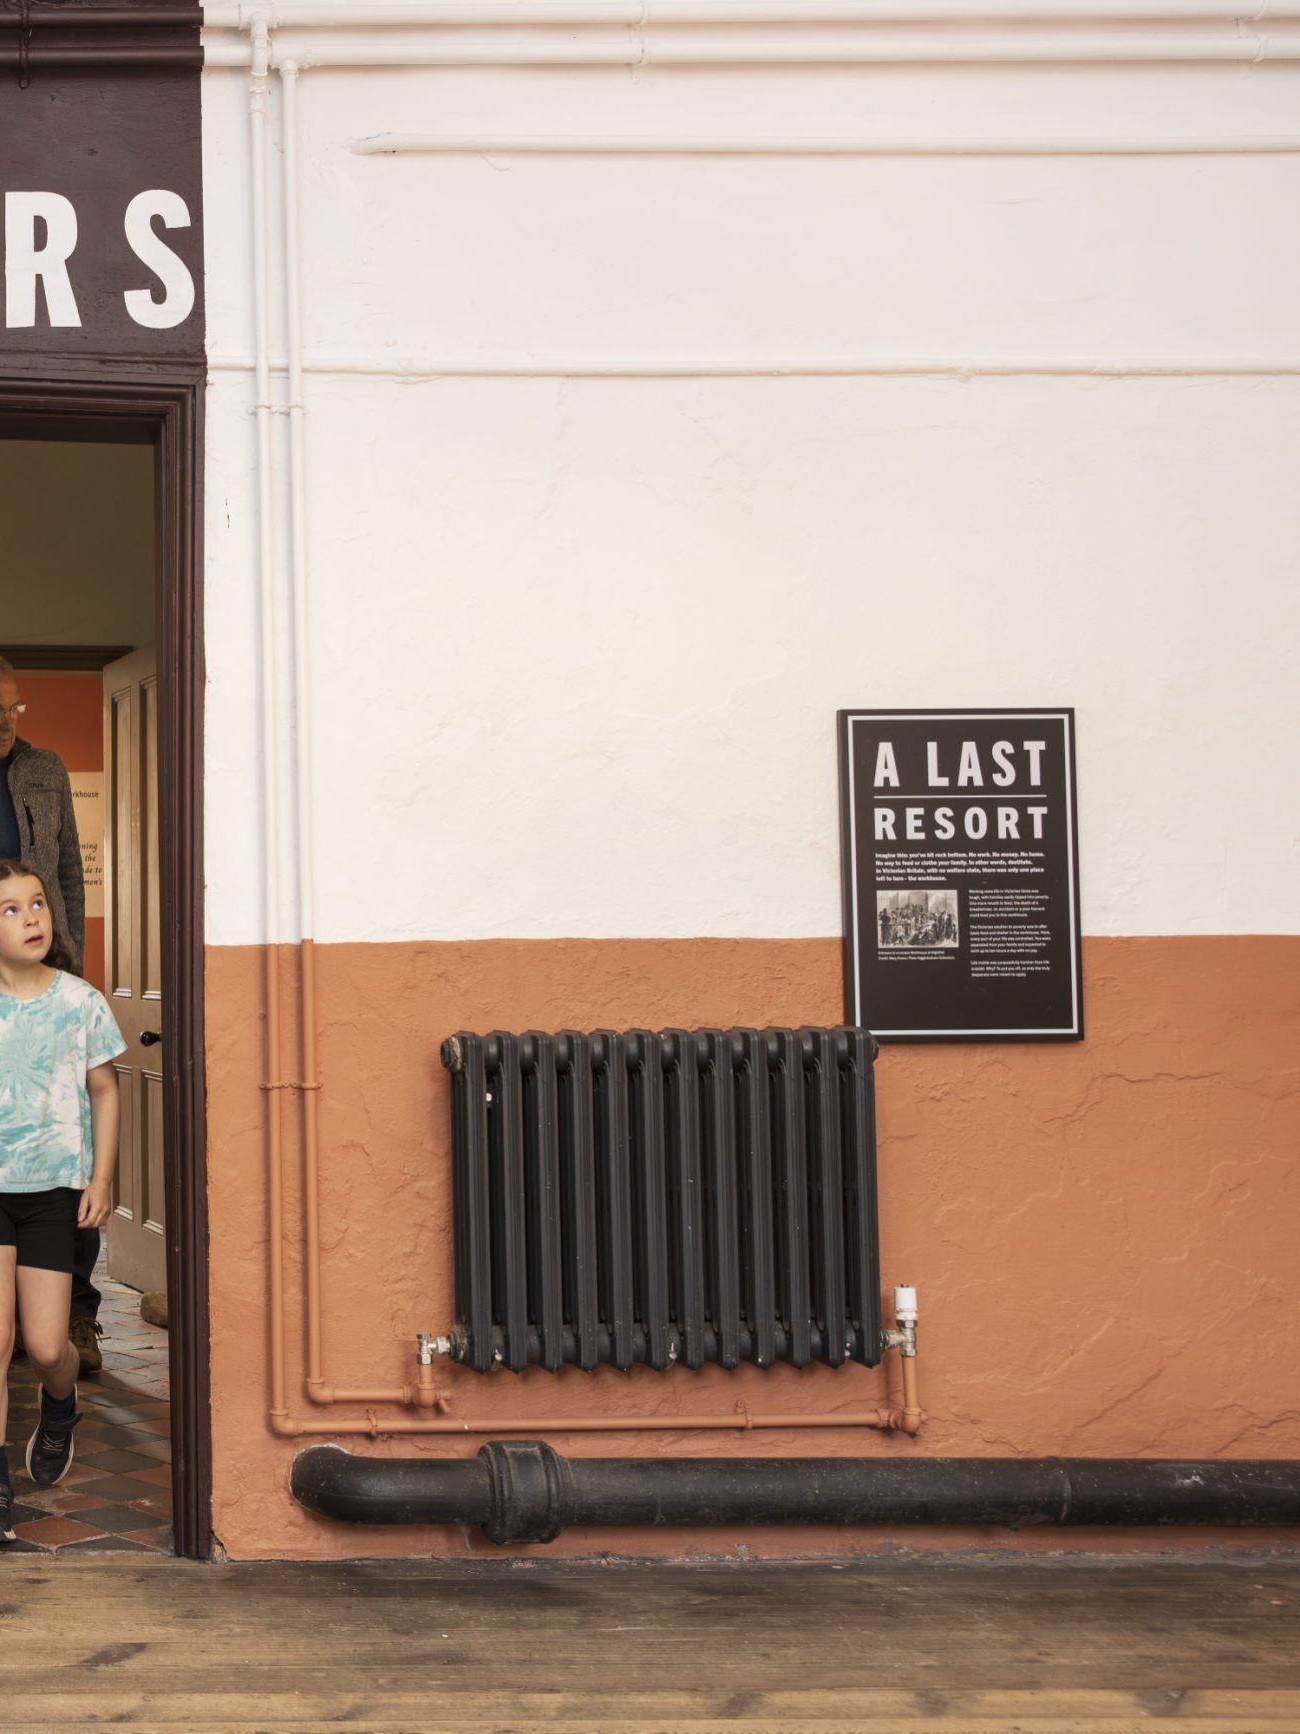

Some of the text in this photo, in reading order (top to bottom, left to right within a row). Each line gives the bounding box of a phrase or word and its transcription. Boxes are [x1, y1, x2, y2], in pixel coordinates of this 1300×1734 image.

[874, 741, 1045, 786] A LAST
[874, 807, 1047, 840] RESORT
